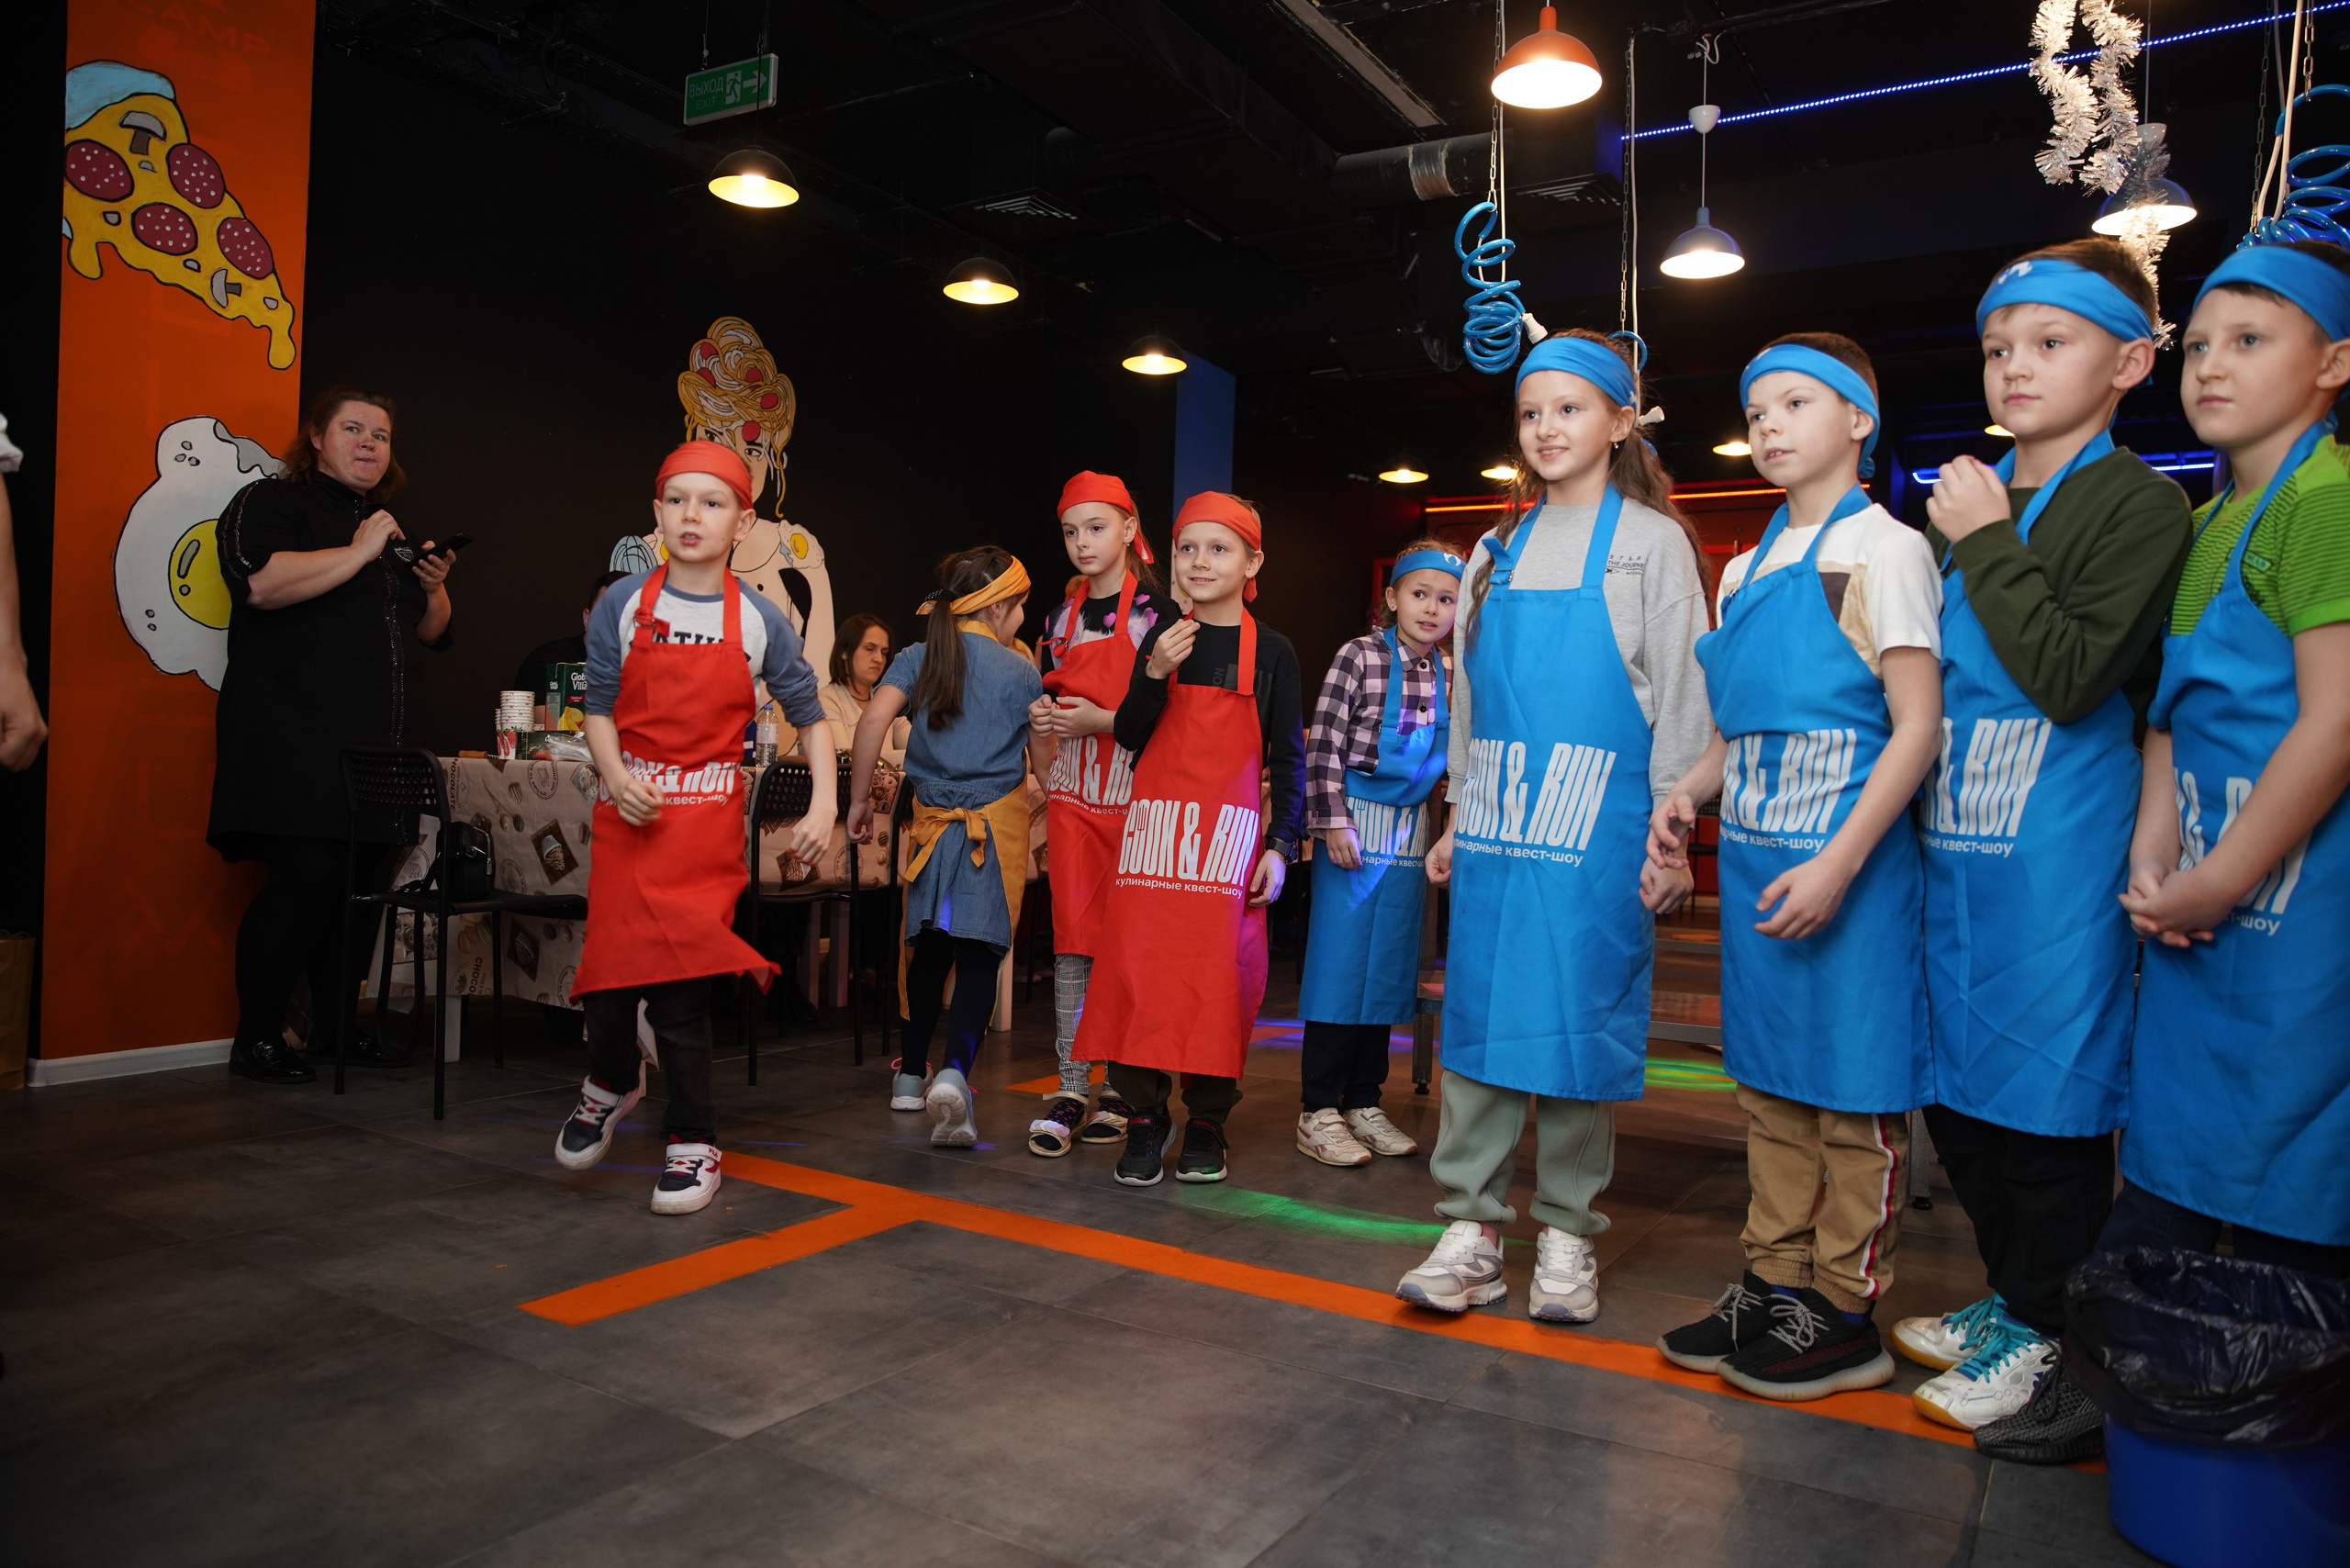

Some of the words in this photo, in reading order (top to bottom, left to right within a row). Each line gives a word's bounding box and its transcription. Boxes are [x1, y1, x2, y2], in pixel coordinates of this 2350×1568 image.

[689, 76, 724, 98] ВЫХОД
[697, 96, 717, 110] EXIT
[571, 672, 587, 681] Glob
[572, 680, 588, 690] Villa
[1082, 735, 1101, 805] &
[1102, 741, 1137, 806] RU
[1761, 728, 1856, 834] RUN
[1957, 717, 2053, 837] RUN
[450, 757, 458, 812] HOCOLATE
[1499, 741, 1528, 843] &
[1524, 742, 1617, 851] RUN
[1118, 799, 1181, 878] COOK
[1178, 801, 1201, 881] &
[1200, 804, 1259, 887] RUN
[1750, 834, 1825, 854] квест-шоу
[1942, 839, 2014, 858] квест-шоу
[1505, 847, 1583, 868] квест-шоу
[1115, 878, 1182, 890] кулинарные
[1184, 881, 1243, 899] квест-шоу
[469, 957, 483, 992] CHOCO
